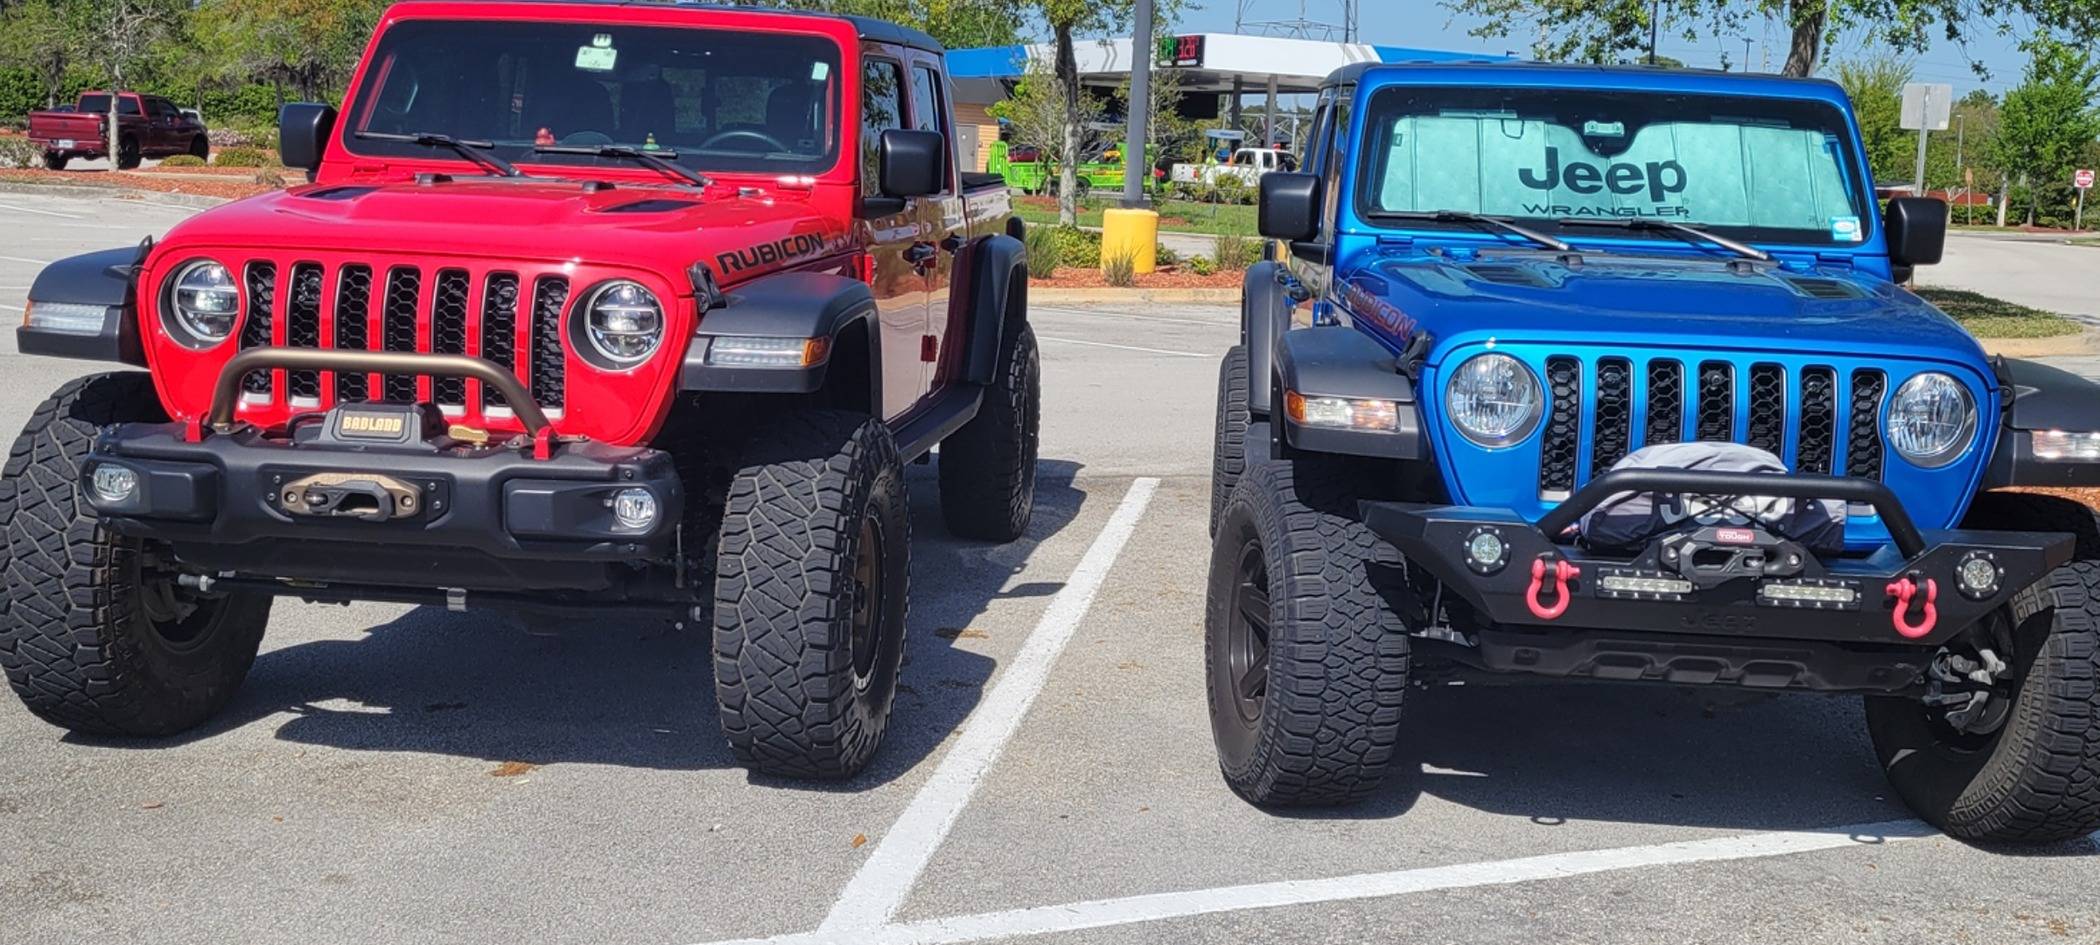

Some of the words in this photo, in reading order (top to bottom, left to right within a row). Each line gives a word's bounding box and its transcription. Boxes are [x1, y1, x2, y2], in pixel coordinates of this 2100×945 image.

[1518, 146, 1688, 203] Jeep
[1522, 204, 1690, 218] WRANGLER
[716, 232, 824, 275] RUBICON
[1347, 283, 1417, 341] RUBICON
[343, 416, 402, 432] BADLAND
[1719, 532, 1750, 540] TOUGH
